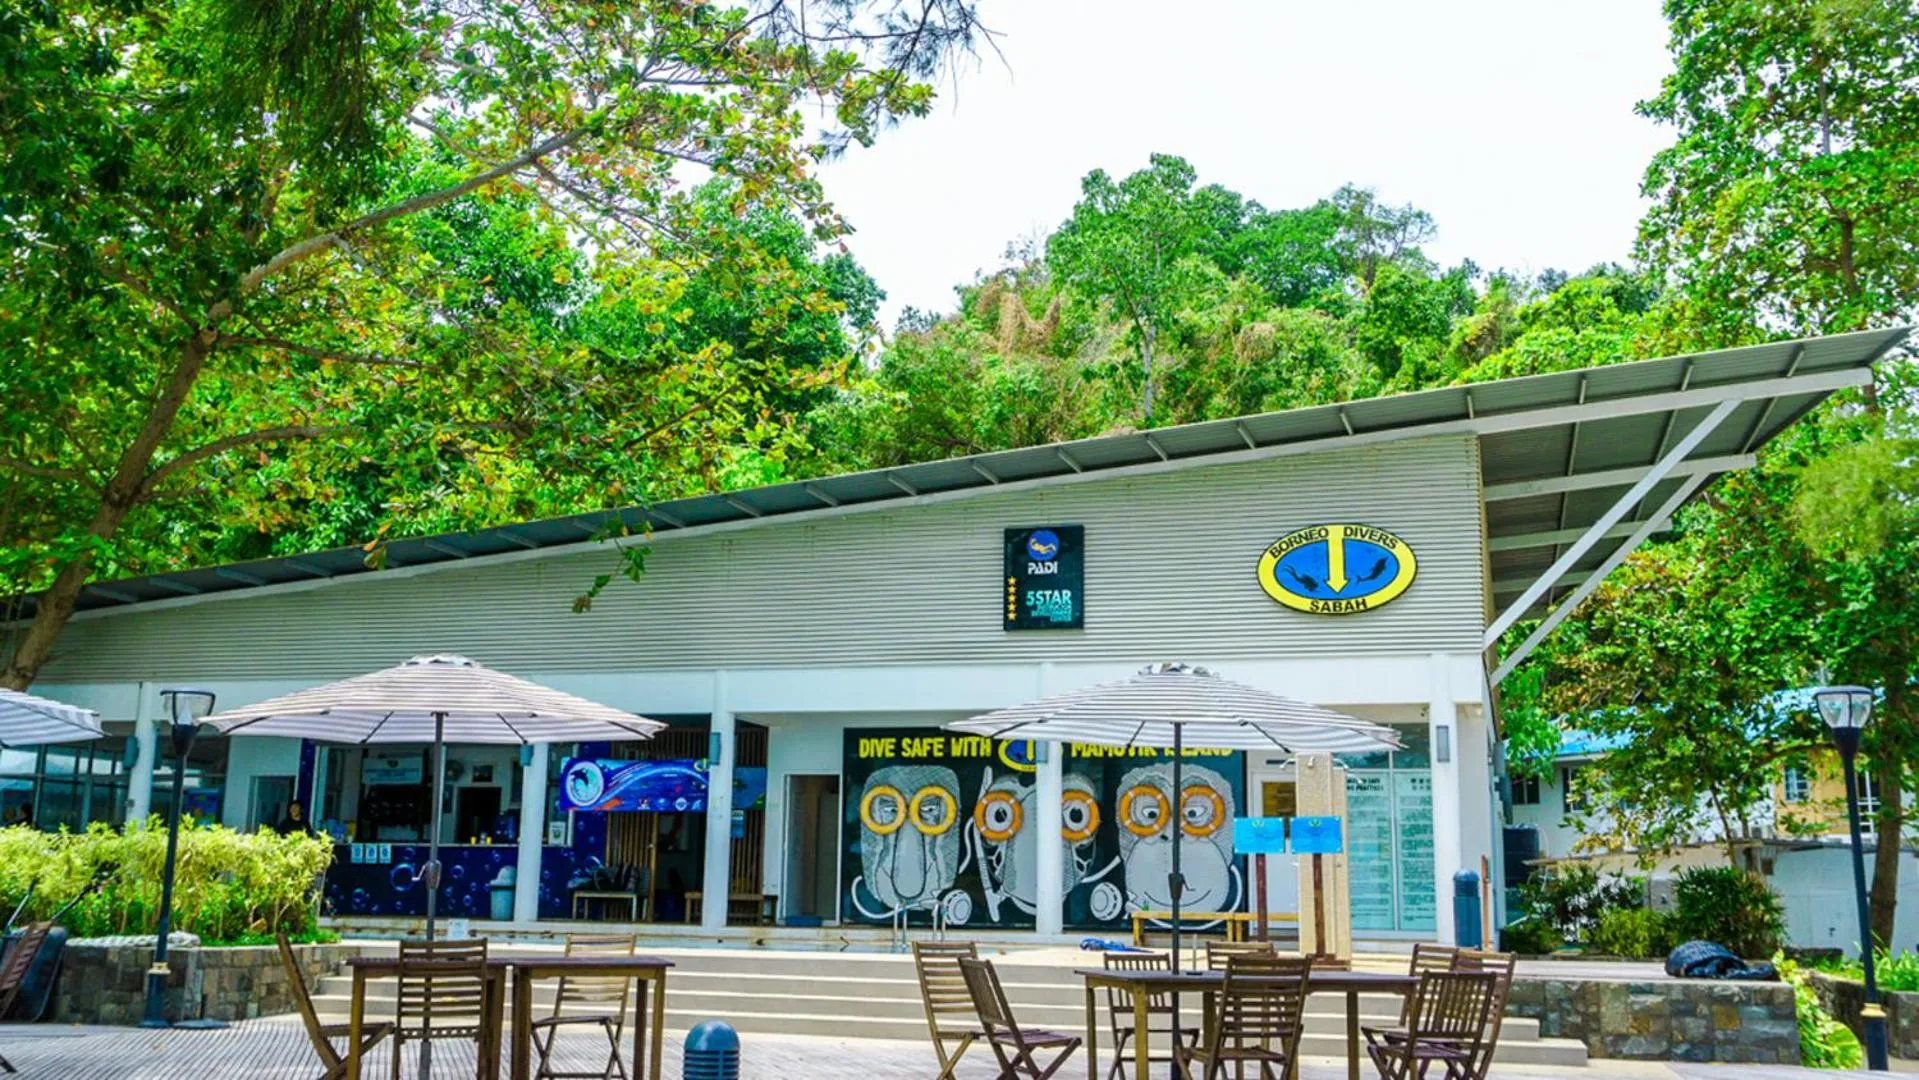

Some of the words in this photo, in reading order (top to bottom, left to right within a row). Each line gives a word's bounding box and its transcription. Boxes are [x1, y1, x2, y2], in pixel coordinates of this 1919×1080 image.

[1269, 527, 1329, 558] BORNEO
[1343, 526, 1398, 549] DIVERS
[1027, 562, 1058, 575] PADI
[1310, 599, 1368, 612] SABAH
[858, 738, 896, 759] DIVE
[901, 737, 945, 758] SAFE
[951, 736, 992, 758] WITH
